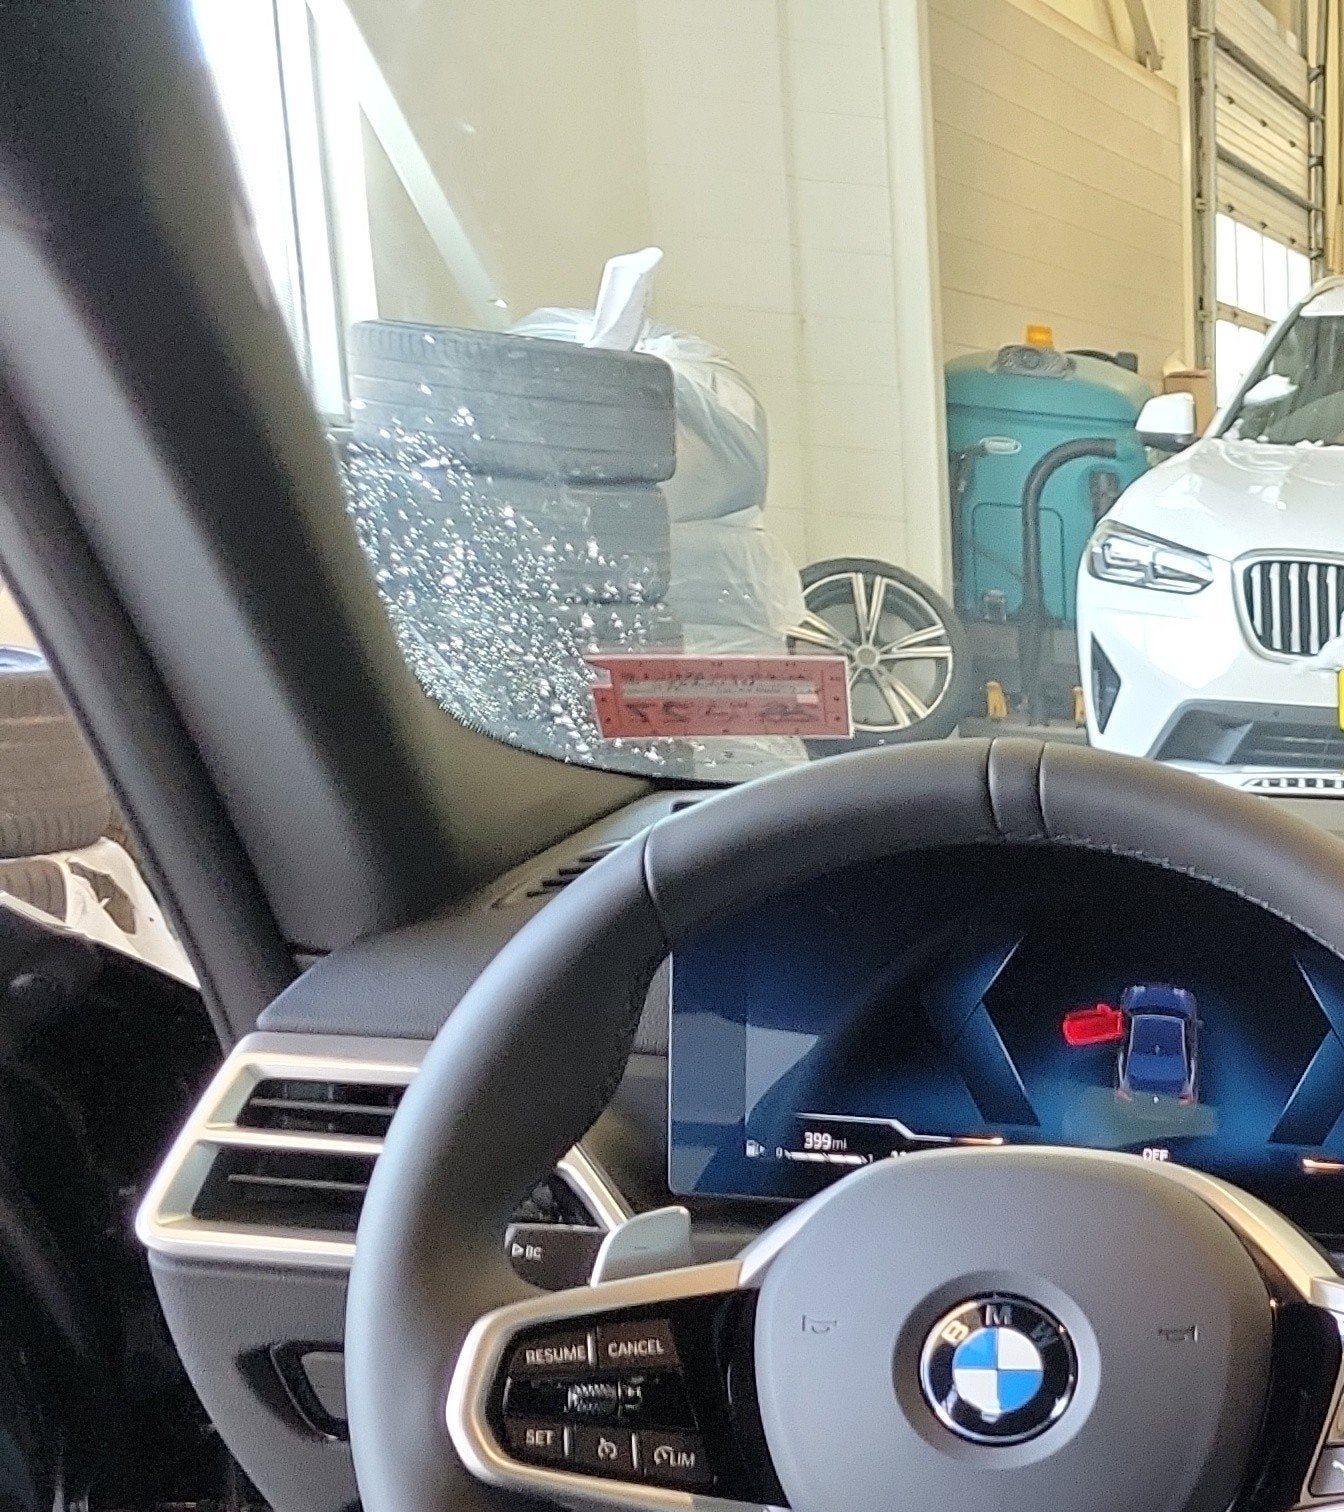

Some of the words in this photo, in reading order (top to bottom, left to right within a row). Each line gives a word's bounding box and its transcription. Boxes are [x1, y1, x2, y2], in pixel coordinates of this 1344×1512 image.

[941, 1303, 1058, 1348] BMW
[525, 1345, 587, 1365] RESUME
[608, 1338, 664, 1358] CANCEL
[525, 1429, 554, 1447] SET
